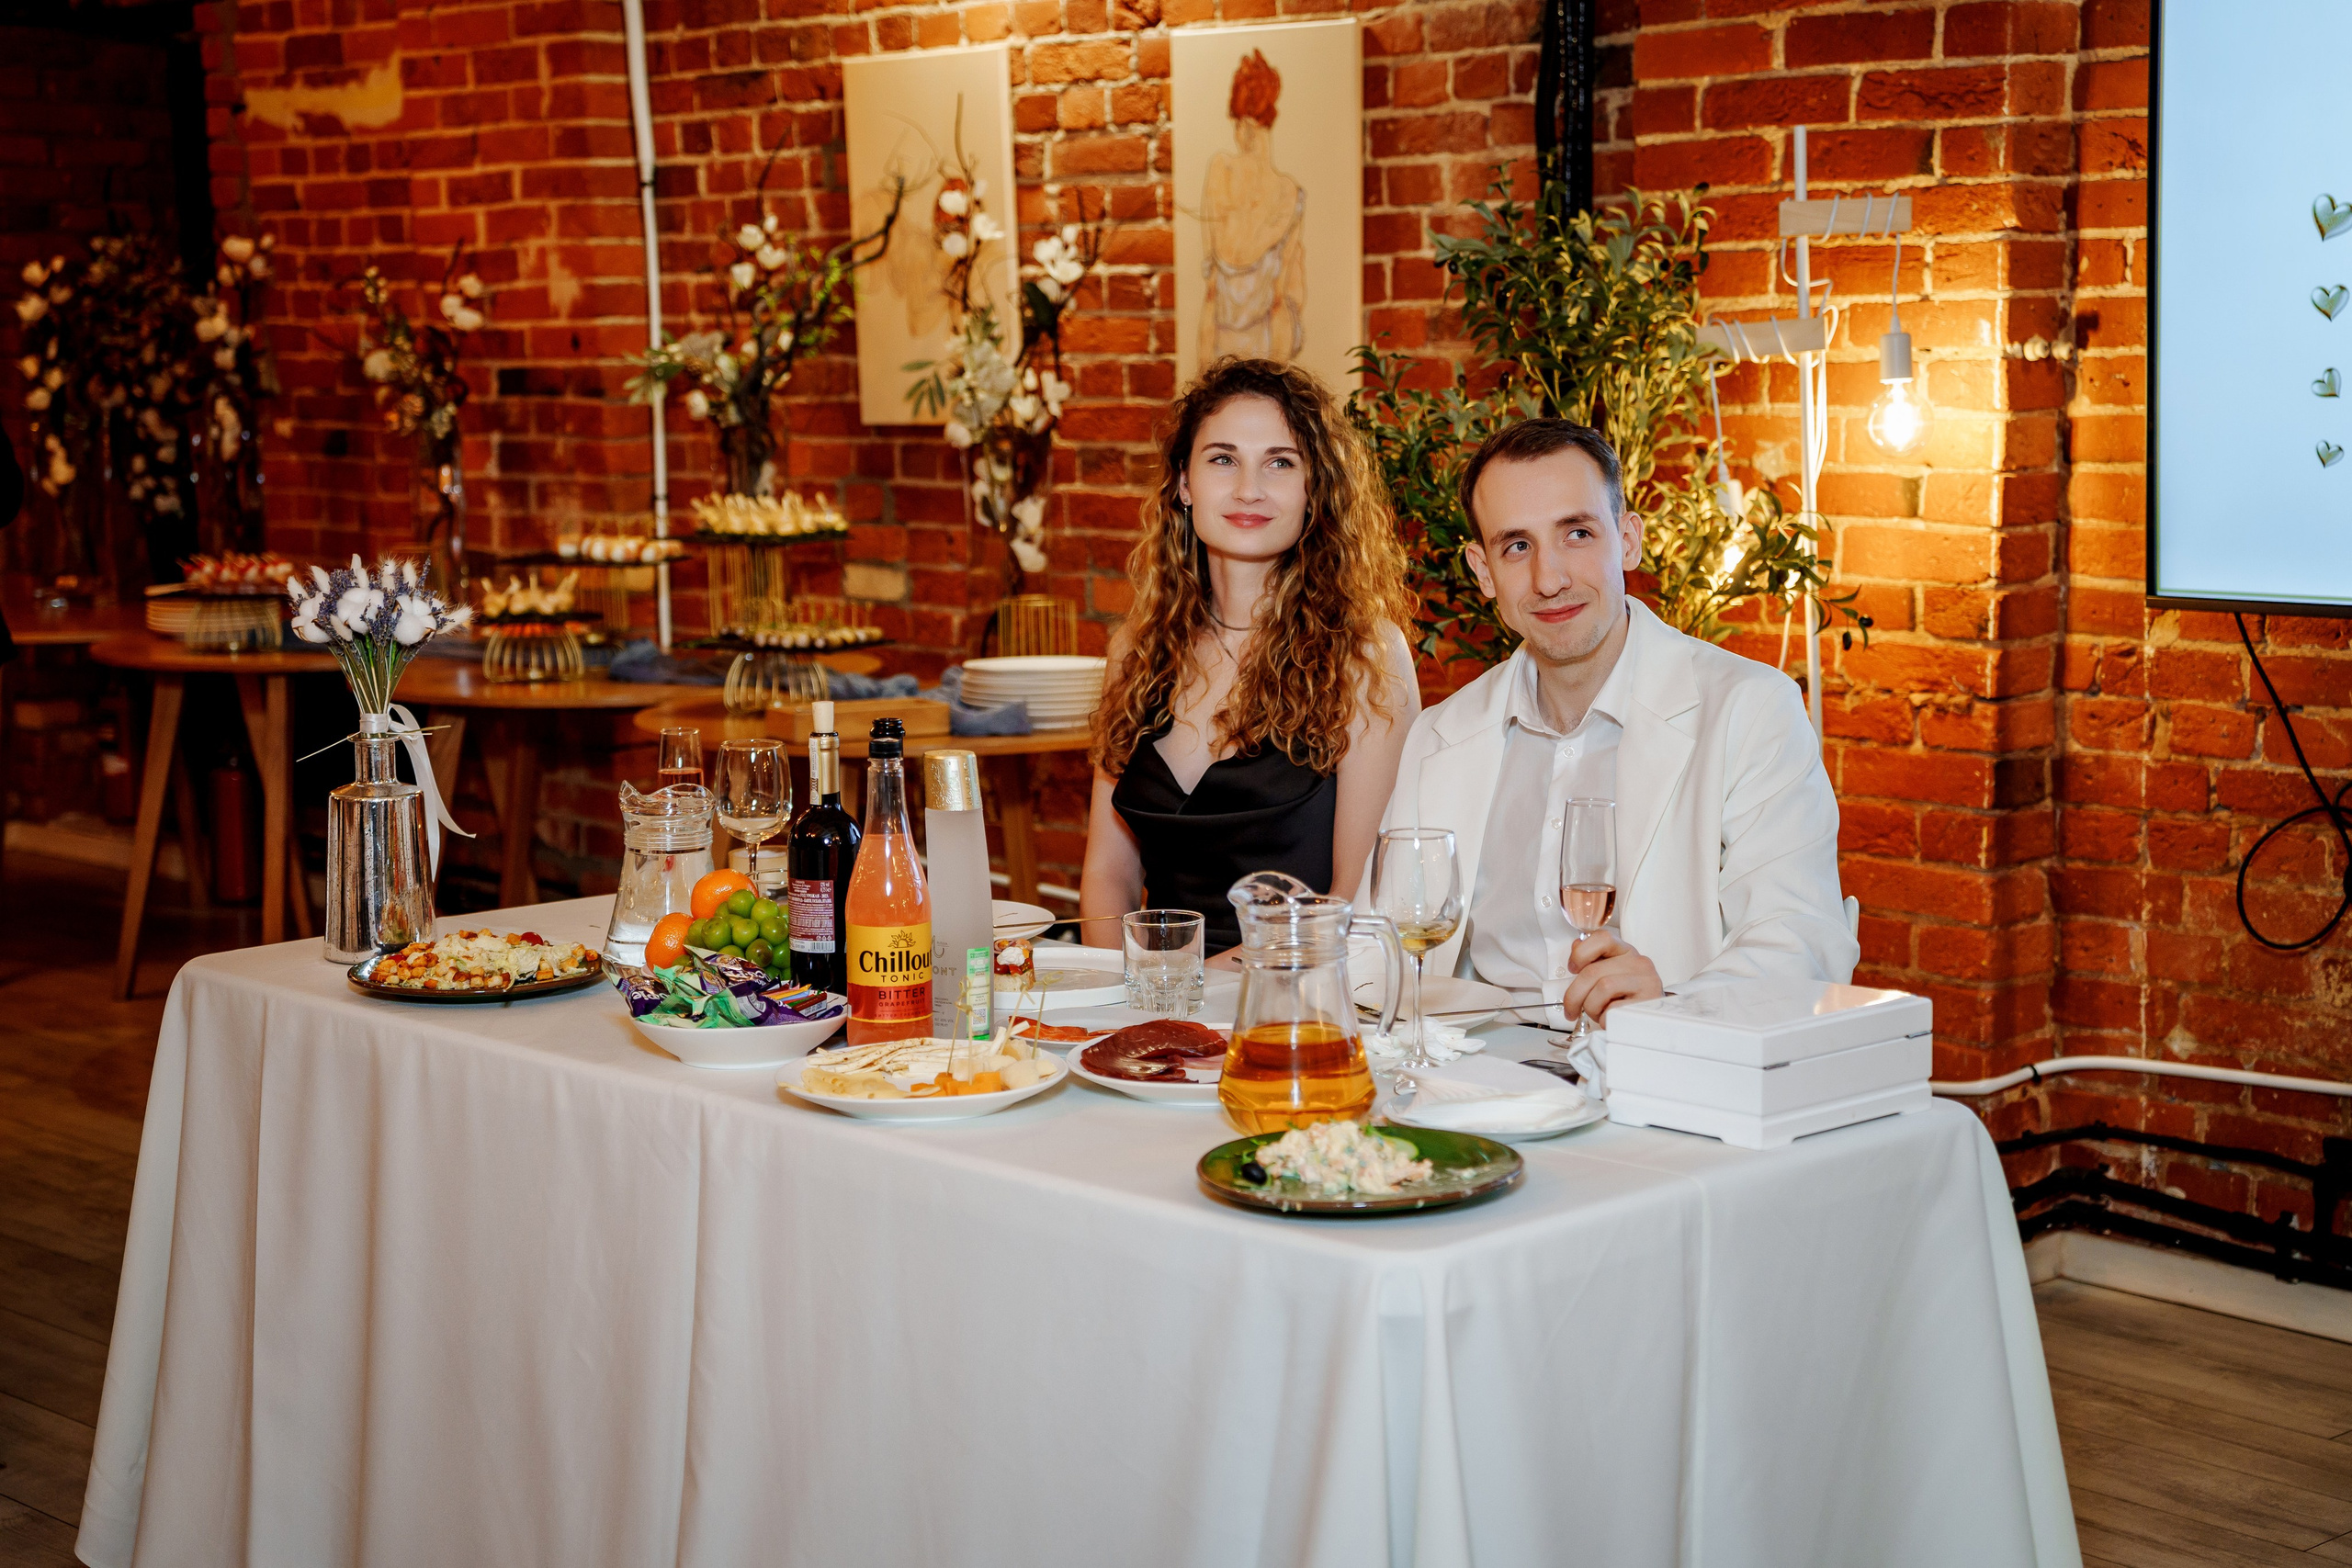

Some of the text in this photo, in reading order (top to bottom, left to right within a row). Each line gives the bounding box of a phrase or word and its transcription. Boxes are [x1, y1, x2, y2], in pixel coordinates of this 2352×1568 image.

[881, 972, 924, 983] TONIC
[878, 987, 925, 1000] BITTER
[878, 998, 925, 1008] GRAPEFRUIT
